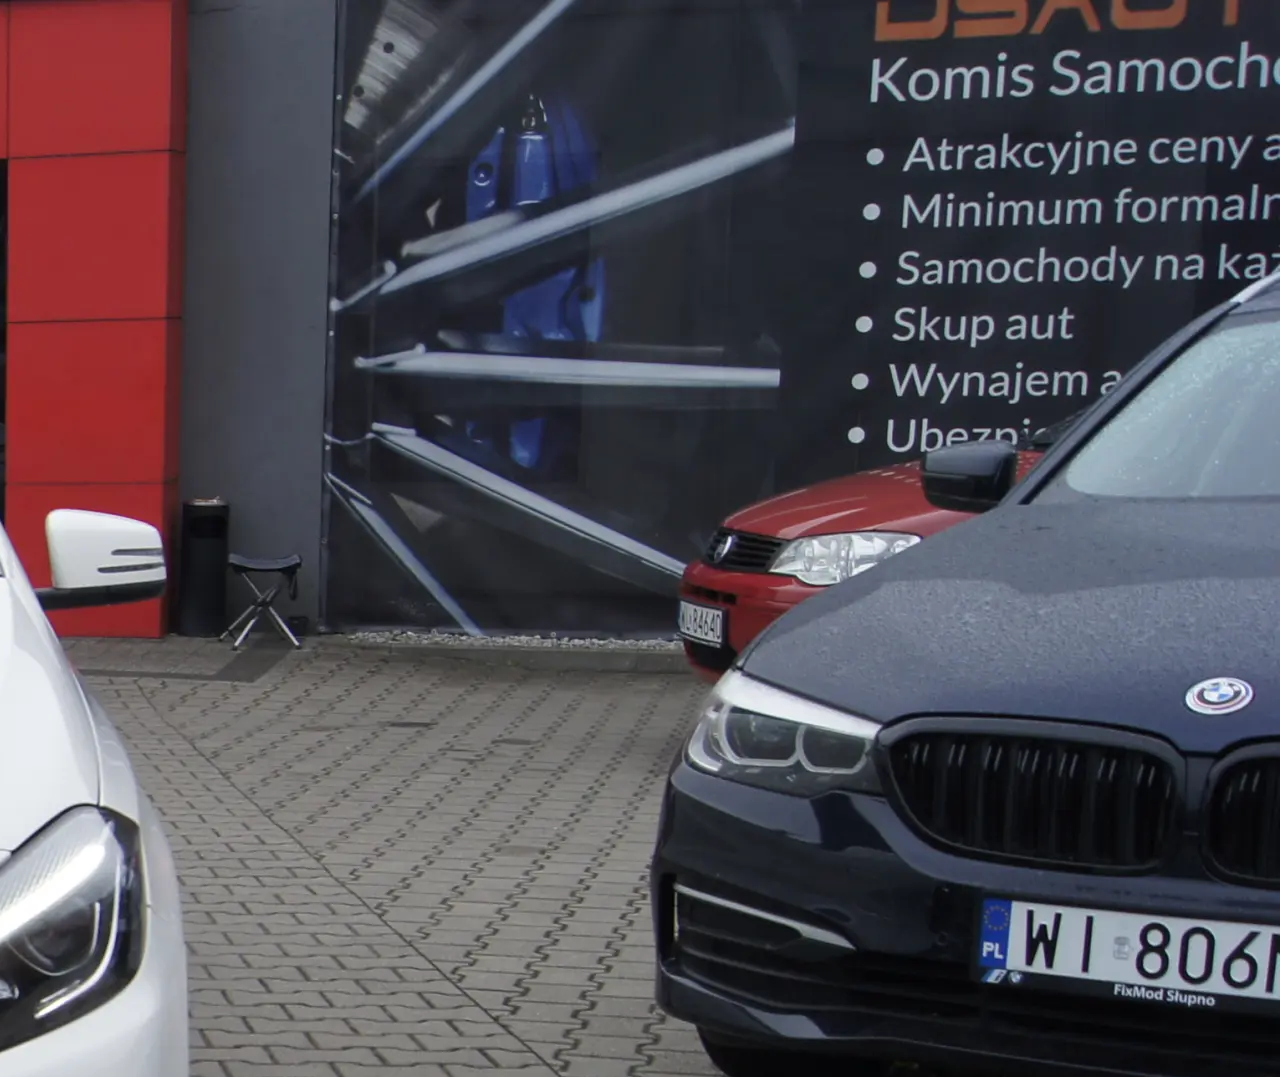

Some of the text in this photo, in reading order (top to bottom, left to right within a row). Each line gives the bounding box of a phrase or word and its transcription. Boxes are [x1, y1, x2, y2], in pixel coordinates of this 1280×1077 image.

[870, 41, 1280, 103] Komis Samoch
[902, 131, 1138, 175] Atrakcyjne
[1149, 134, 1254, 171] ceny
[902, 191, 1102, 228] Minimum
[896, 246, 1144, 288] Samochody
[1154, 253, 1205, 281] na
[892, 306, 1075, 348] Skup aut
[889, 362, 1089, 404] Wynajem
[982, 941, 1003, 959] PL
[1024, 909, 1094, 973] WI
[1113, 984, 1216, 1006] FixMod Słupno
